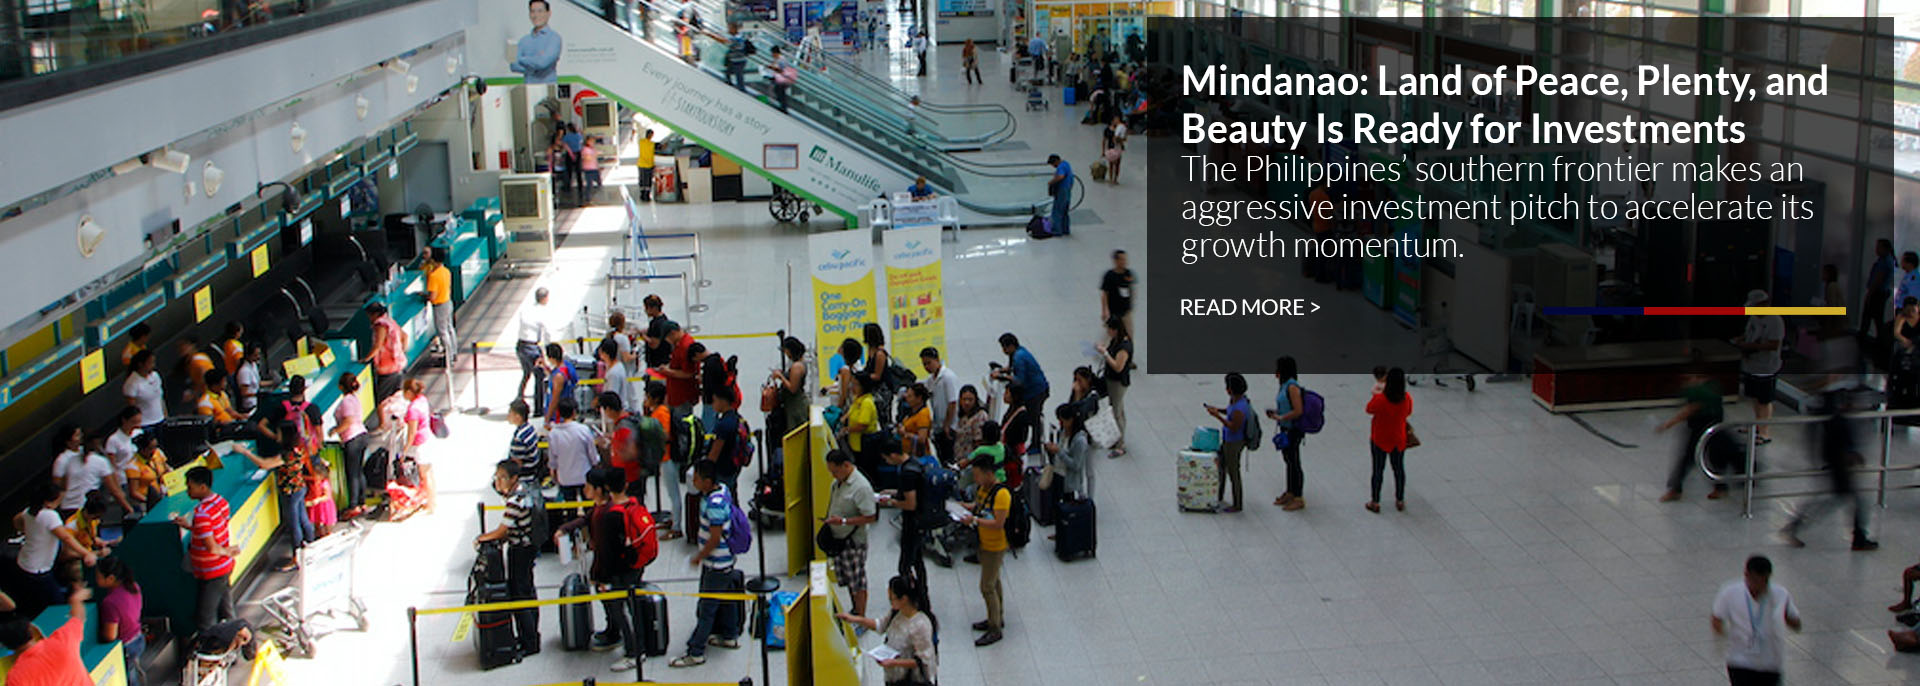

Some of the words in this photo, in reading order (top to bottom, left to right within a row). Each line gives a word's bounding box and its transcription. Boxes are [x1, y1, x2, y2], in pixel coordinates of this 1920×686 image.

[642, 62, 673, 85] Every
[671, 79, 714, 106] journey
[715, 98, 735, 116] has
[743, 117, 772, 135] story
[825, 155, 881, 192] Manulife
[820, 291, 842, 301] One
[821, 298, 867, 311] Carry-On
[822, 309, 867, 321] Baggage
[823, 323, 847, 333] Only
